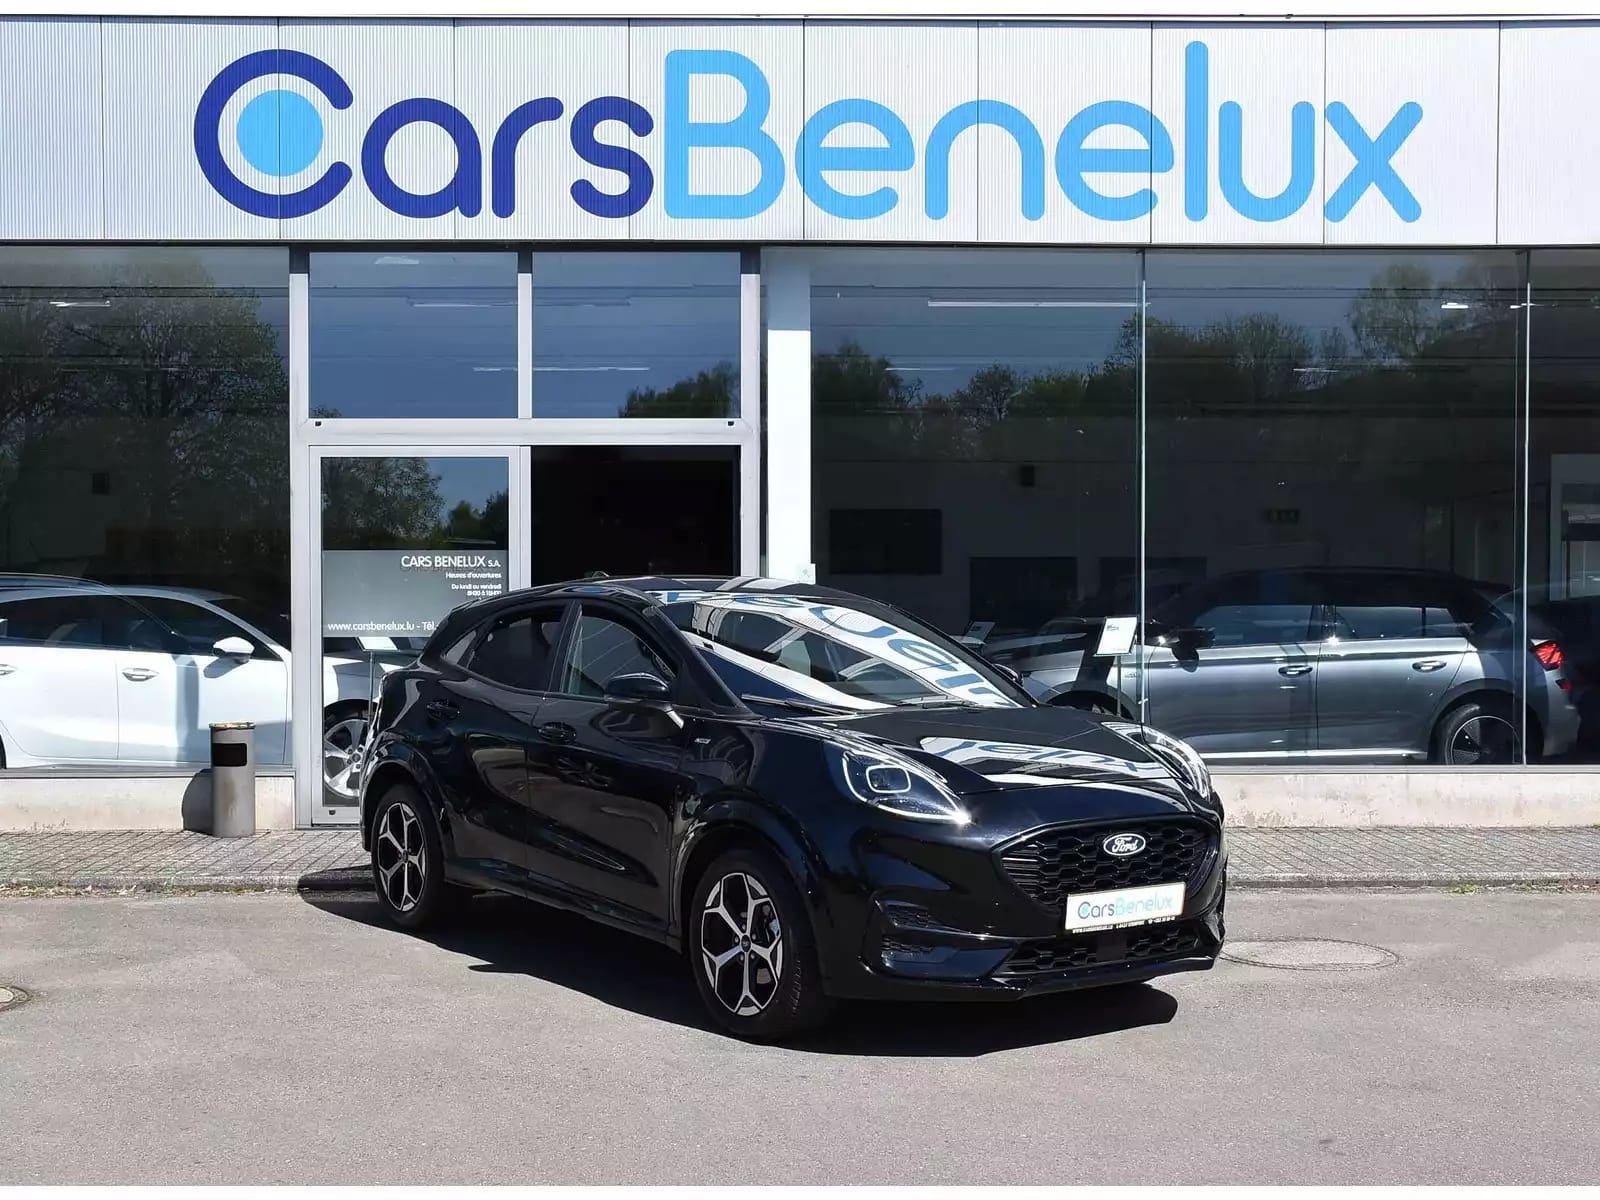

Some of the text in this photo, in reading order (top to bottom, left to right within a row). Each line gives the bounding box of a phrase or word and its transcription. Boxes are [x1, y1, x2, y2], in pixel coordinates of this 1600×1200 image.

[193, 41, 1423, 222] CarsBenelux
[401, 555, 501, 568] CARS BENELUX S.A.
[327, 621, 415, 631] www.carsbenelux.lu
[1111, 836, 1138, 853] Ford
[1077, 891, 1173, 920] CarsBenelux
